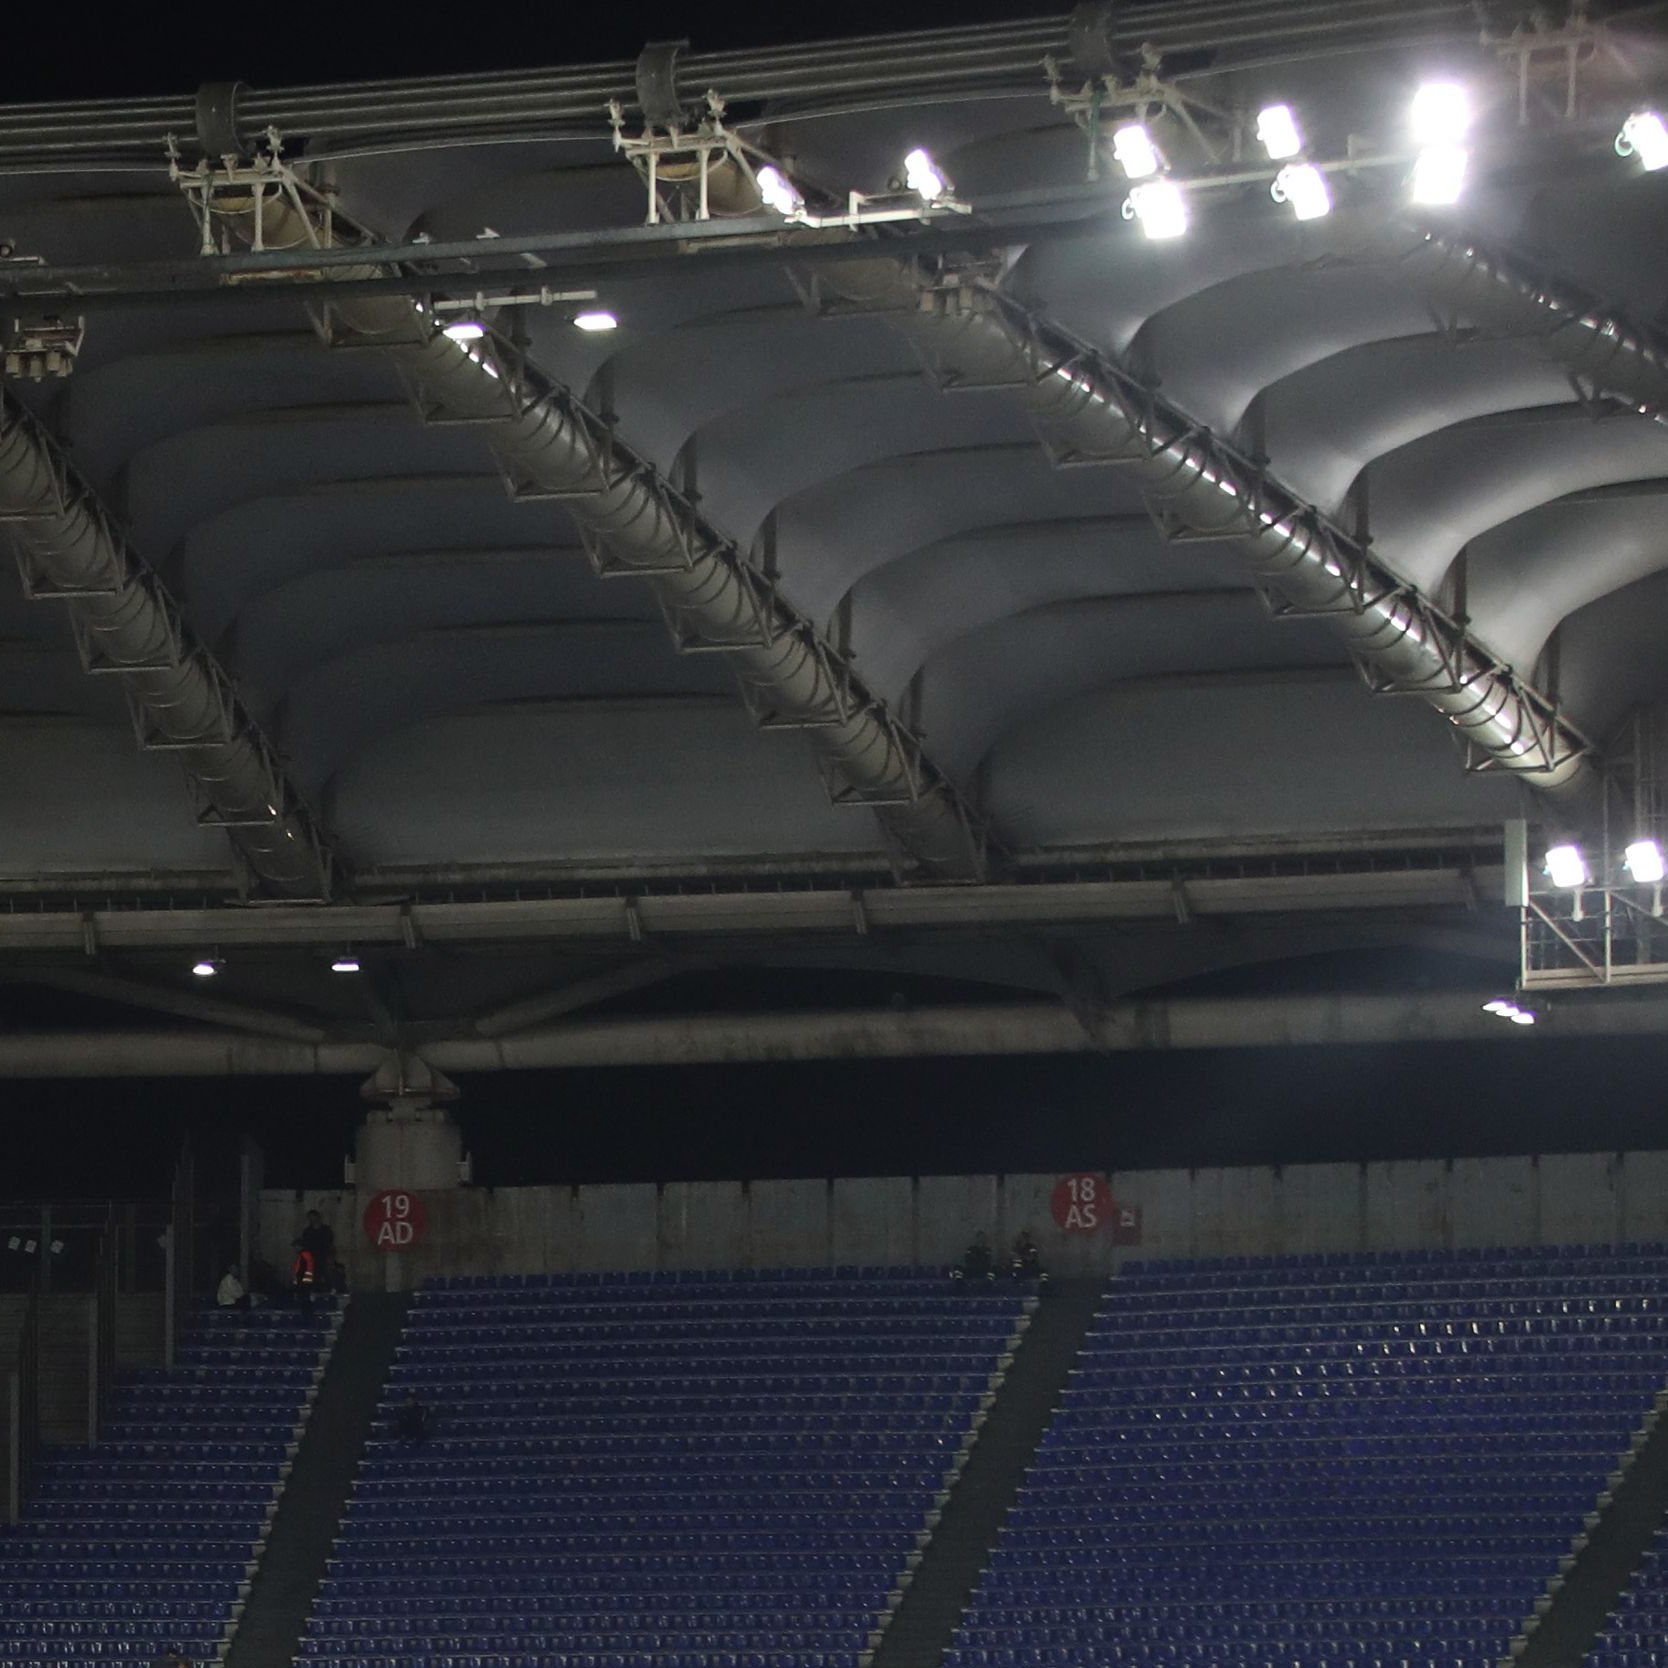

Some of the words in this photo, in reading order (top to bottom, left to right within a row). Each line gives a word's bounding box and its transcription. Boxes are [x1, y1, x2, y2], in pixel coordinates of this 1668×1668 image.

[1067, 1177, 1095, 1202] 18
[381, 1195, 410, 1218] 19
[1064, 1204, 1097, 1229] AS
[377, 1222, 414, 1246] AD
